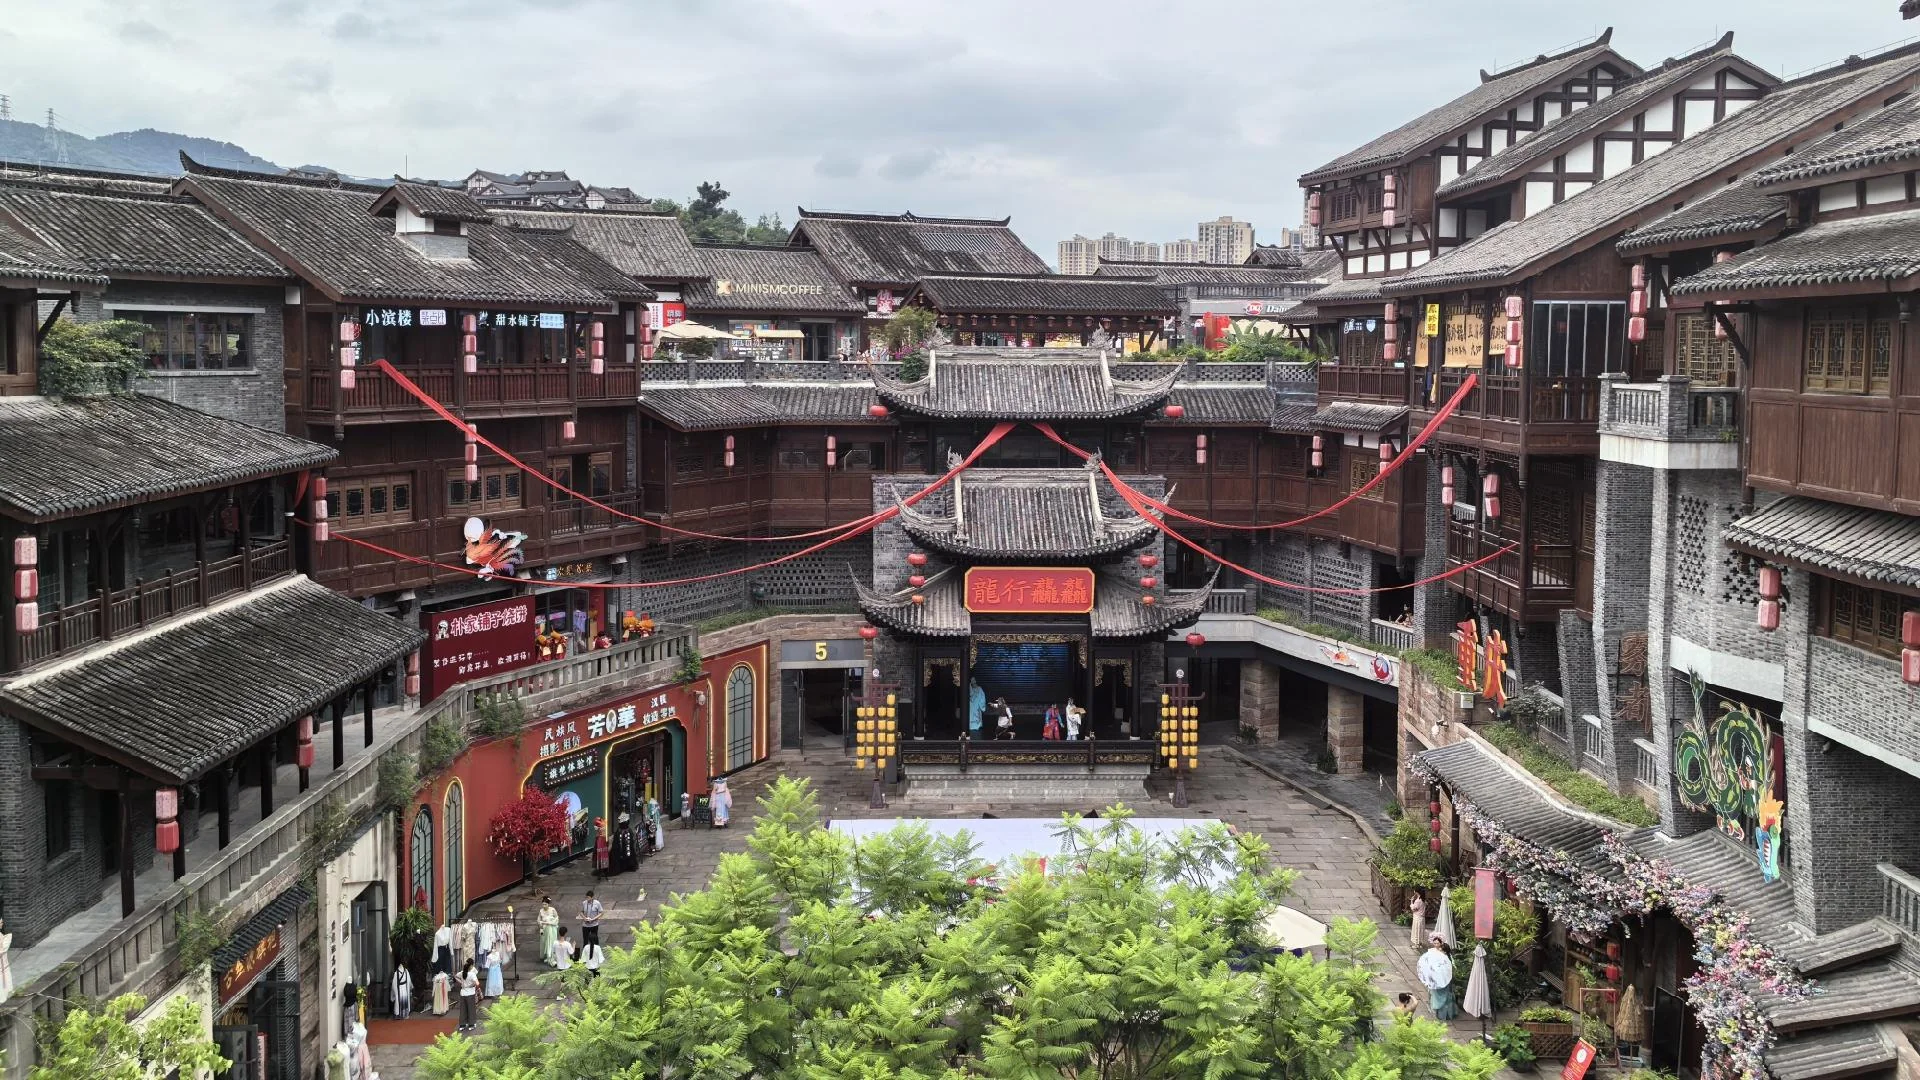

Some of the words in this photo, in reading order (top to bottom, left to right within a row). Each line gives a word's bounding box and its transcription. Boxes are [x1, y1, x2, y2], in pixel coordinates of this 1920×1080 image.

[365, 309, 412, 327] 小滨楼
[495, 313, 540, 327] 甜水铺子
[450, 605, 528, 637] 朴家铺子烧饼
[815, 642, 828, 661] 5
[544, 721, 577, 742] 民族风
